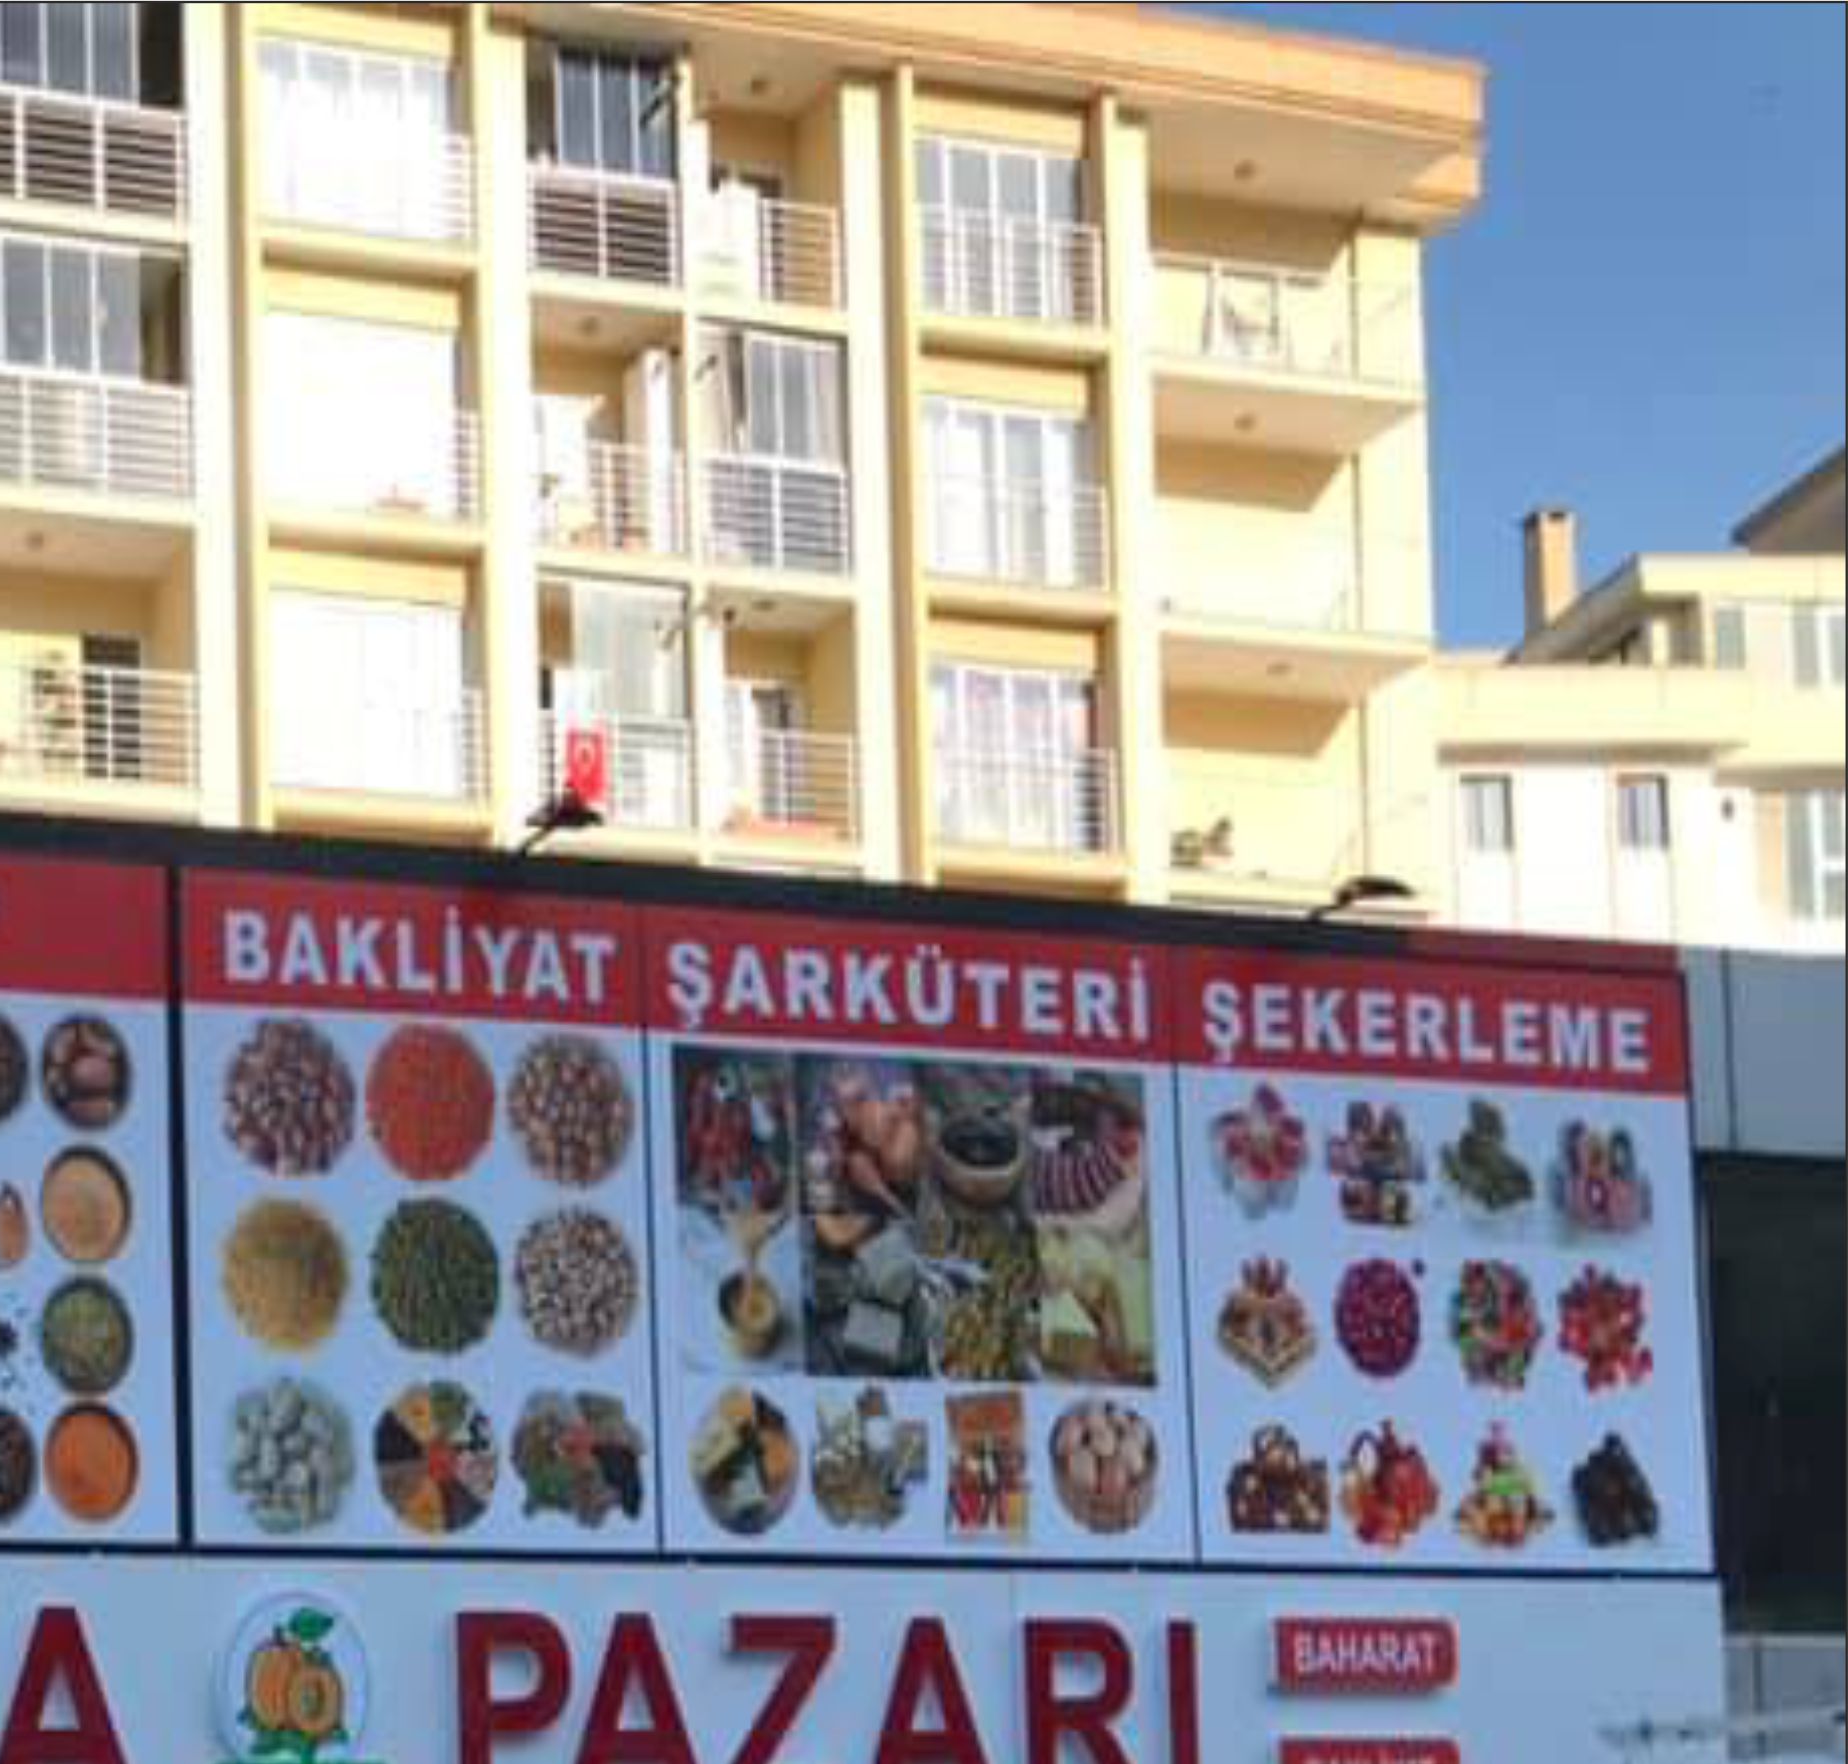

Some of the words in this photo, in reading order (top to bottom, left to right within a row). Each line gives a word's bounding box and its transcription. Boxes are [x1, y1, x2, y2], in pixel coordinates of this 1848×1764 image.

[223, 905, 617, 1000] BAKLİYAT
[668, 942, 1148, 1040] ŞARKÜTERİ
[1201, 982, 1649, 1073] ŞEKERLEME
[1292, 1628, 1436, 1675] BAHARAT
